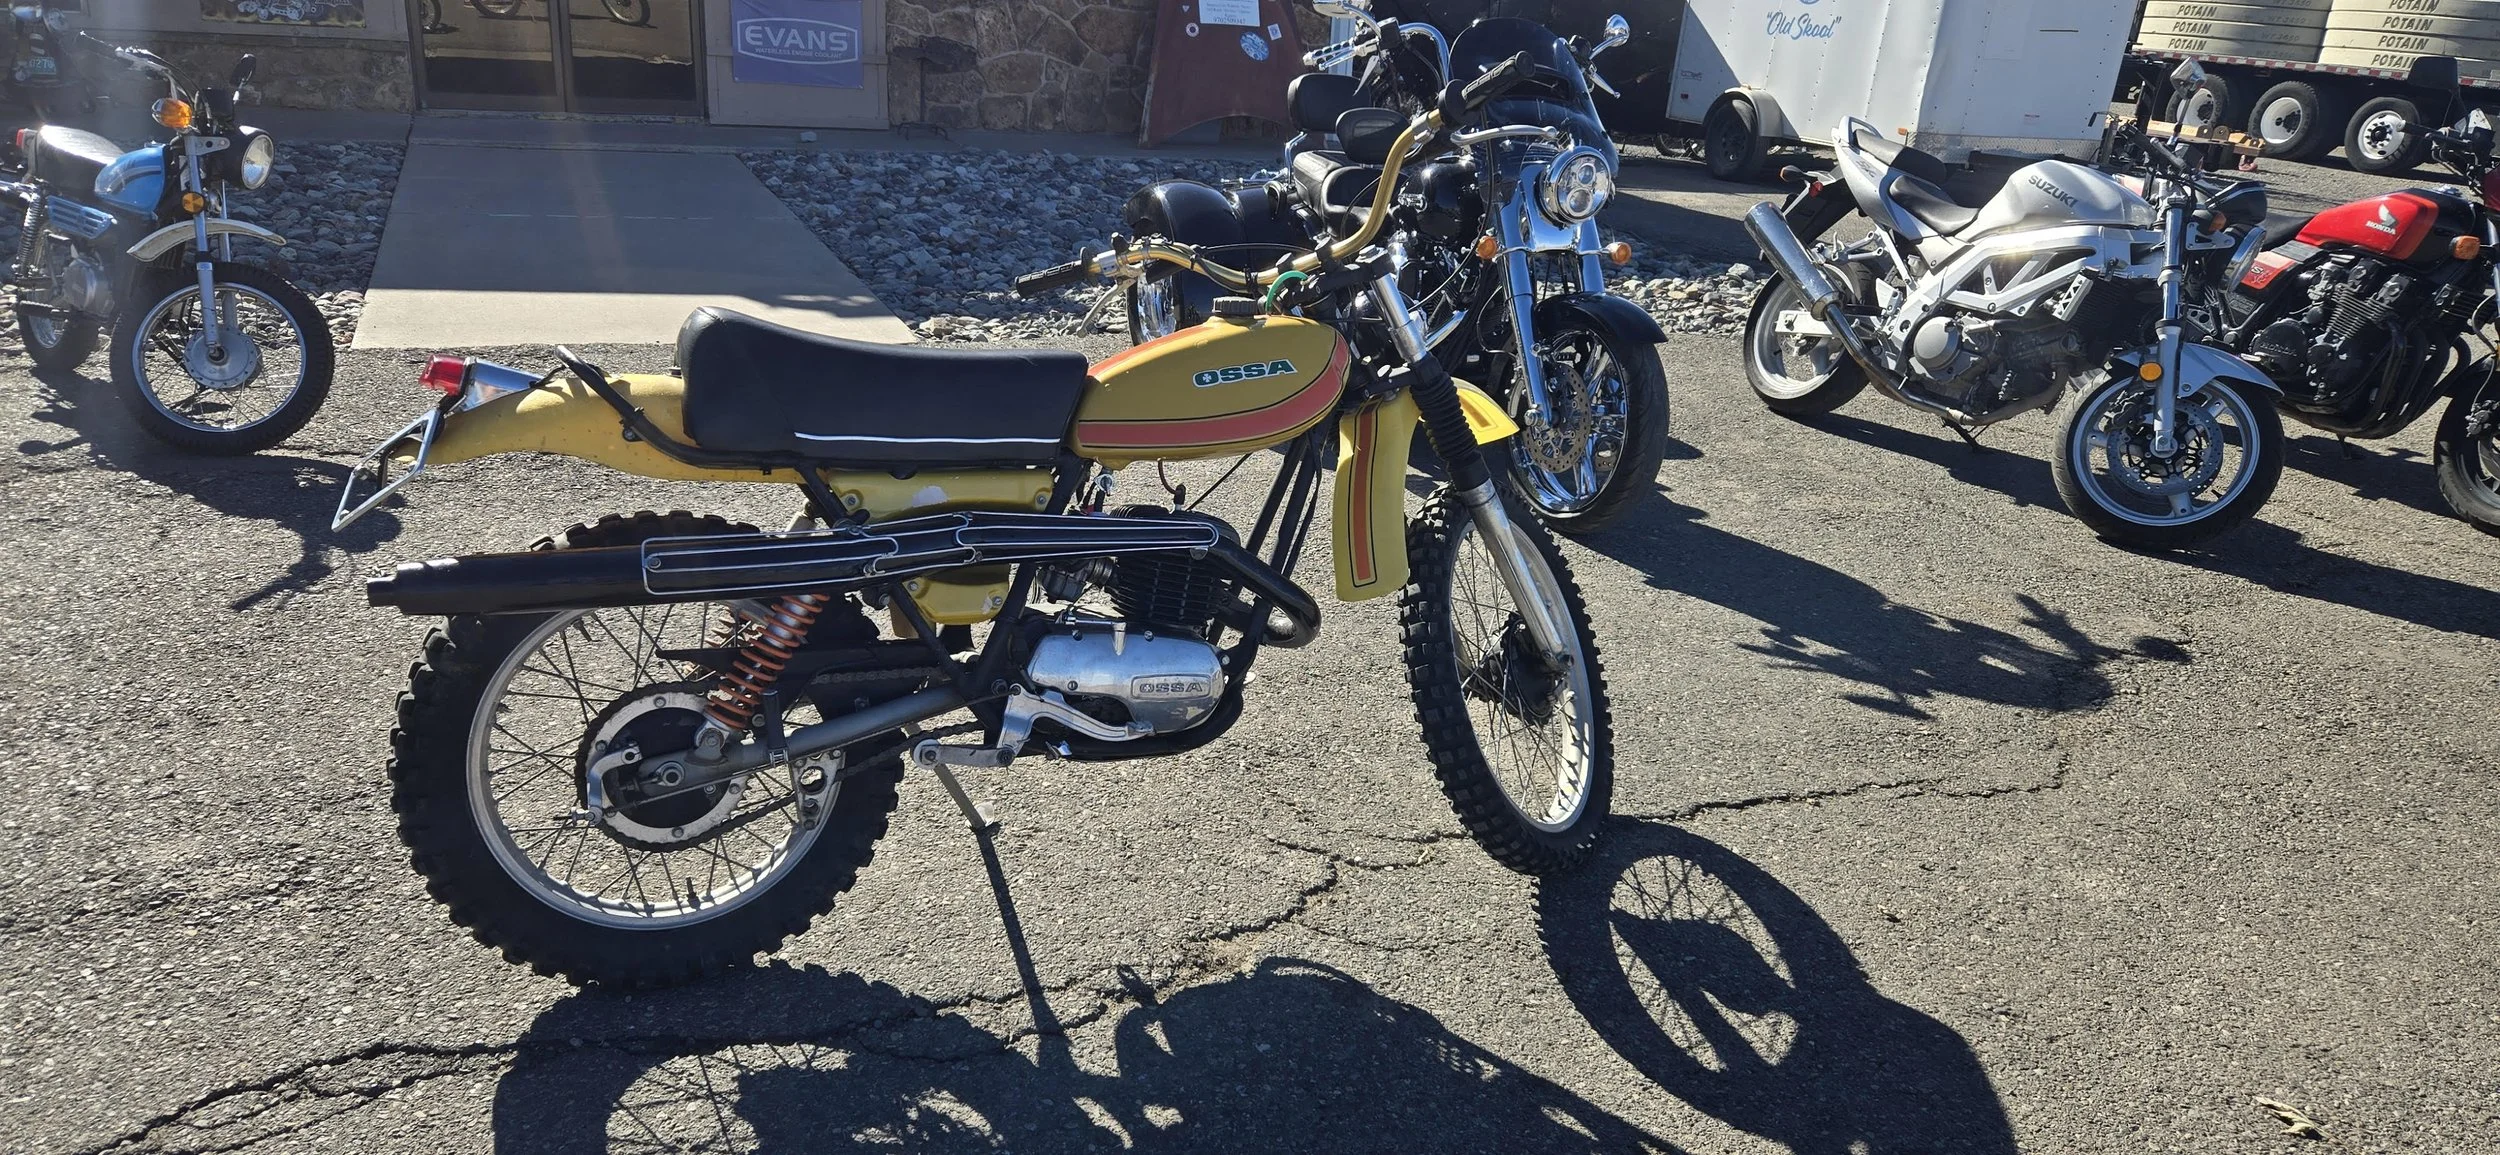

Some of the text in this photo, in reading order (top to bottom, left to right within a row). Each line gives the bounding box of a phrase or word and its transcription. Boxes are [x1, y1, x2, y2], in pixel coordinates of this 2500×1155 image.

[2176, 4, 2217, 17] POTAIN
[2389, 0, 2439, 12] POTAIN
[1767, 11, 1795, 35] "Old
[2172, 21, 2212, 34] POTAIN
[2382, 16, 2434, 31] POTAIN
[745, 25, 848, 52] EVANS
[2168, 38, 2208, 51] POTAIN
[2377, 35, 2430, 50] POTAIN
[755, 47, 790, 56] WATERLESS
[814, 51, 842, 59] COOLANT
[2028, 174, 2079, 208] SUZUKI
[2365, 220, 2396, 235] HONDA
[1193, 359, 1298, 388] OSSA
[1139, 682, 1203, 693] OSSA
